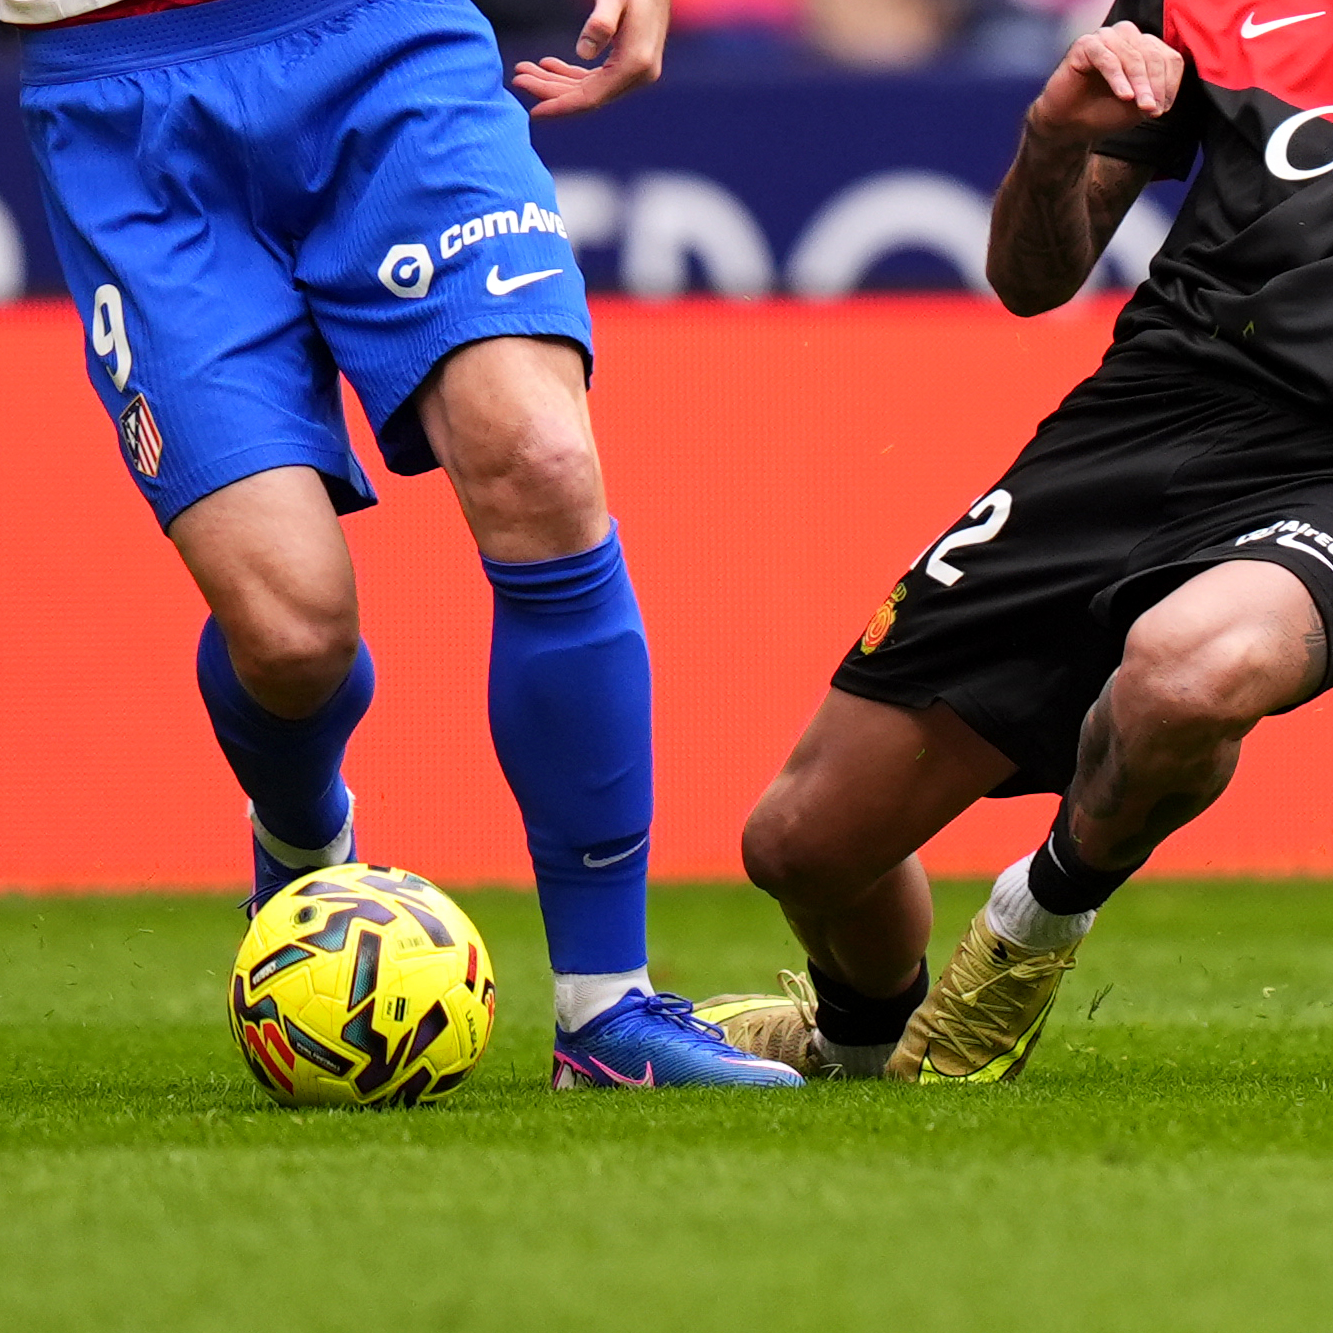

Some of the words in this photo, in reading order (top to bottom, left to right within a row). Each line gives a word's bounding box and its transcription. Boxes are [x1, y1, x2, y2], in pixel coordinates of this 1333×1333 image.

[439, 202, 568, 260] ComAve
[92, 283, 132, 393] 9
[909, 488, 1013, 587] 2
